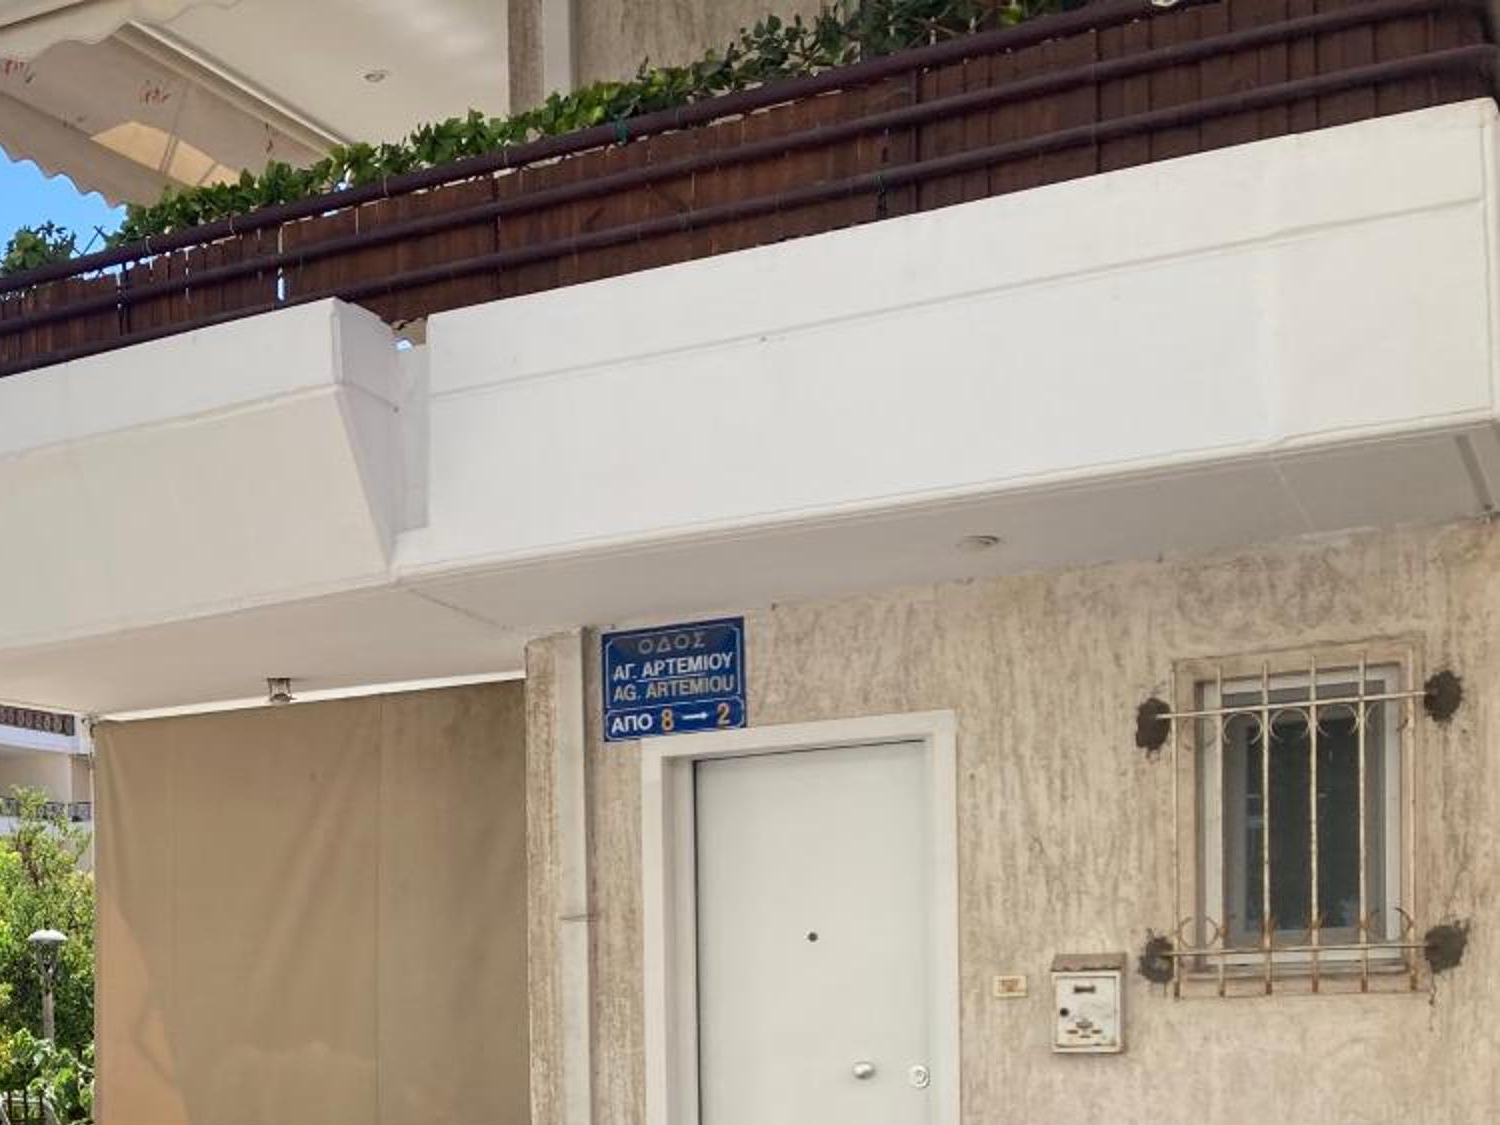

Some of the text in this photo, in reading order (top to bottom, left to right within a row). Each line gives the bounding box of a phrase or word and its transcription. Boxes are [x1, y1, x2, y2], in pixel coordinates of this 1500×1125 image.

[638, 632, 706, 654] ΟΔΟΣ
[613, 652, 733, 681] ΑΓ. ΑΡΤΕΜΙΟΥ
[613, 674, 734, 702] AG. ARTEMIOU
[611, 702, 731, 734] ΑΠΟ 8 2
